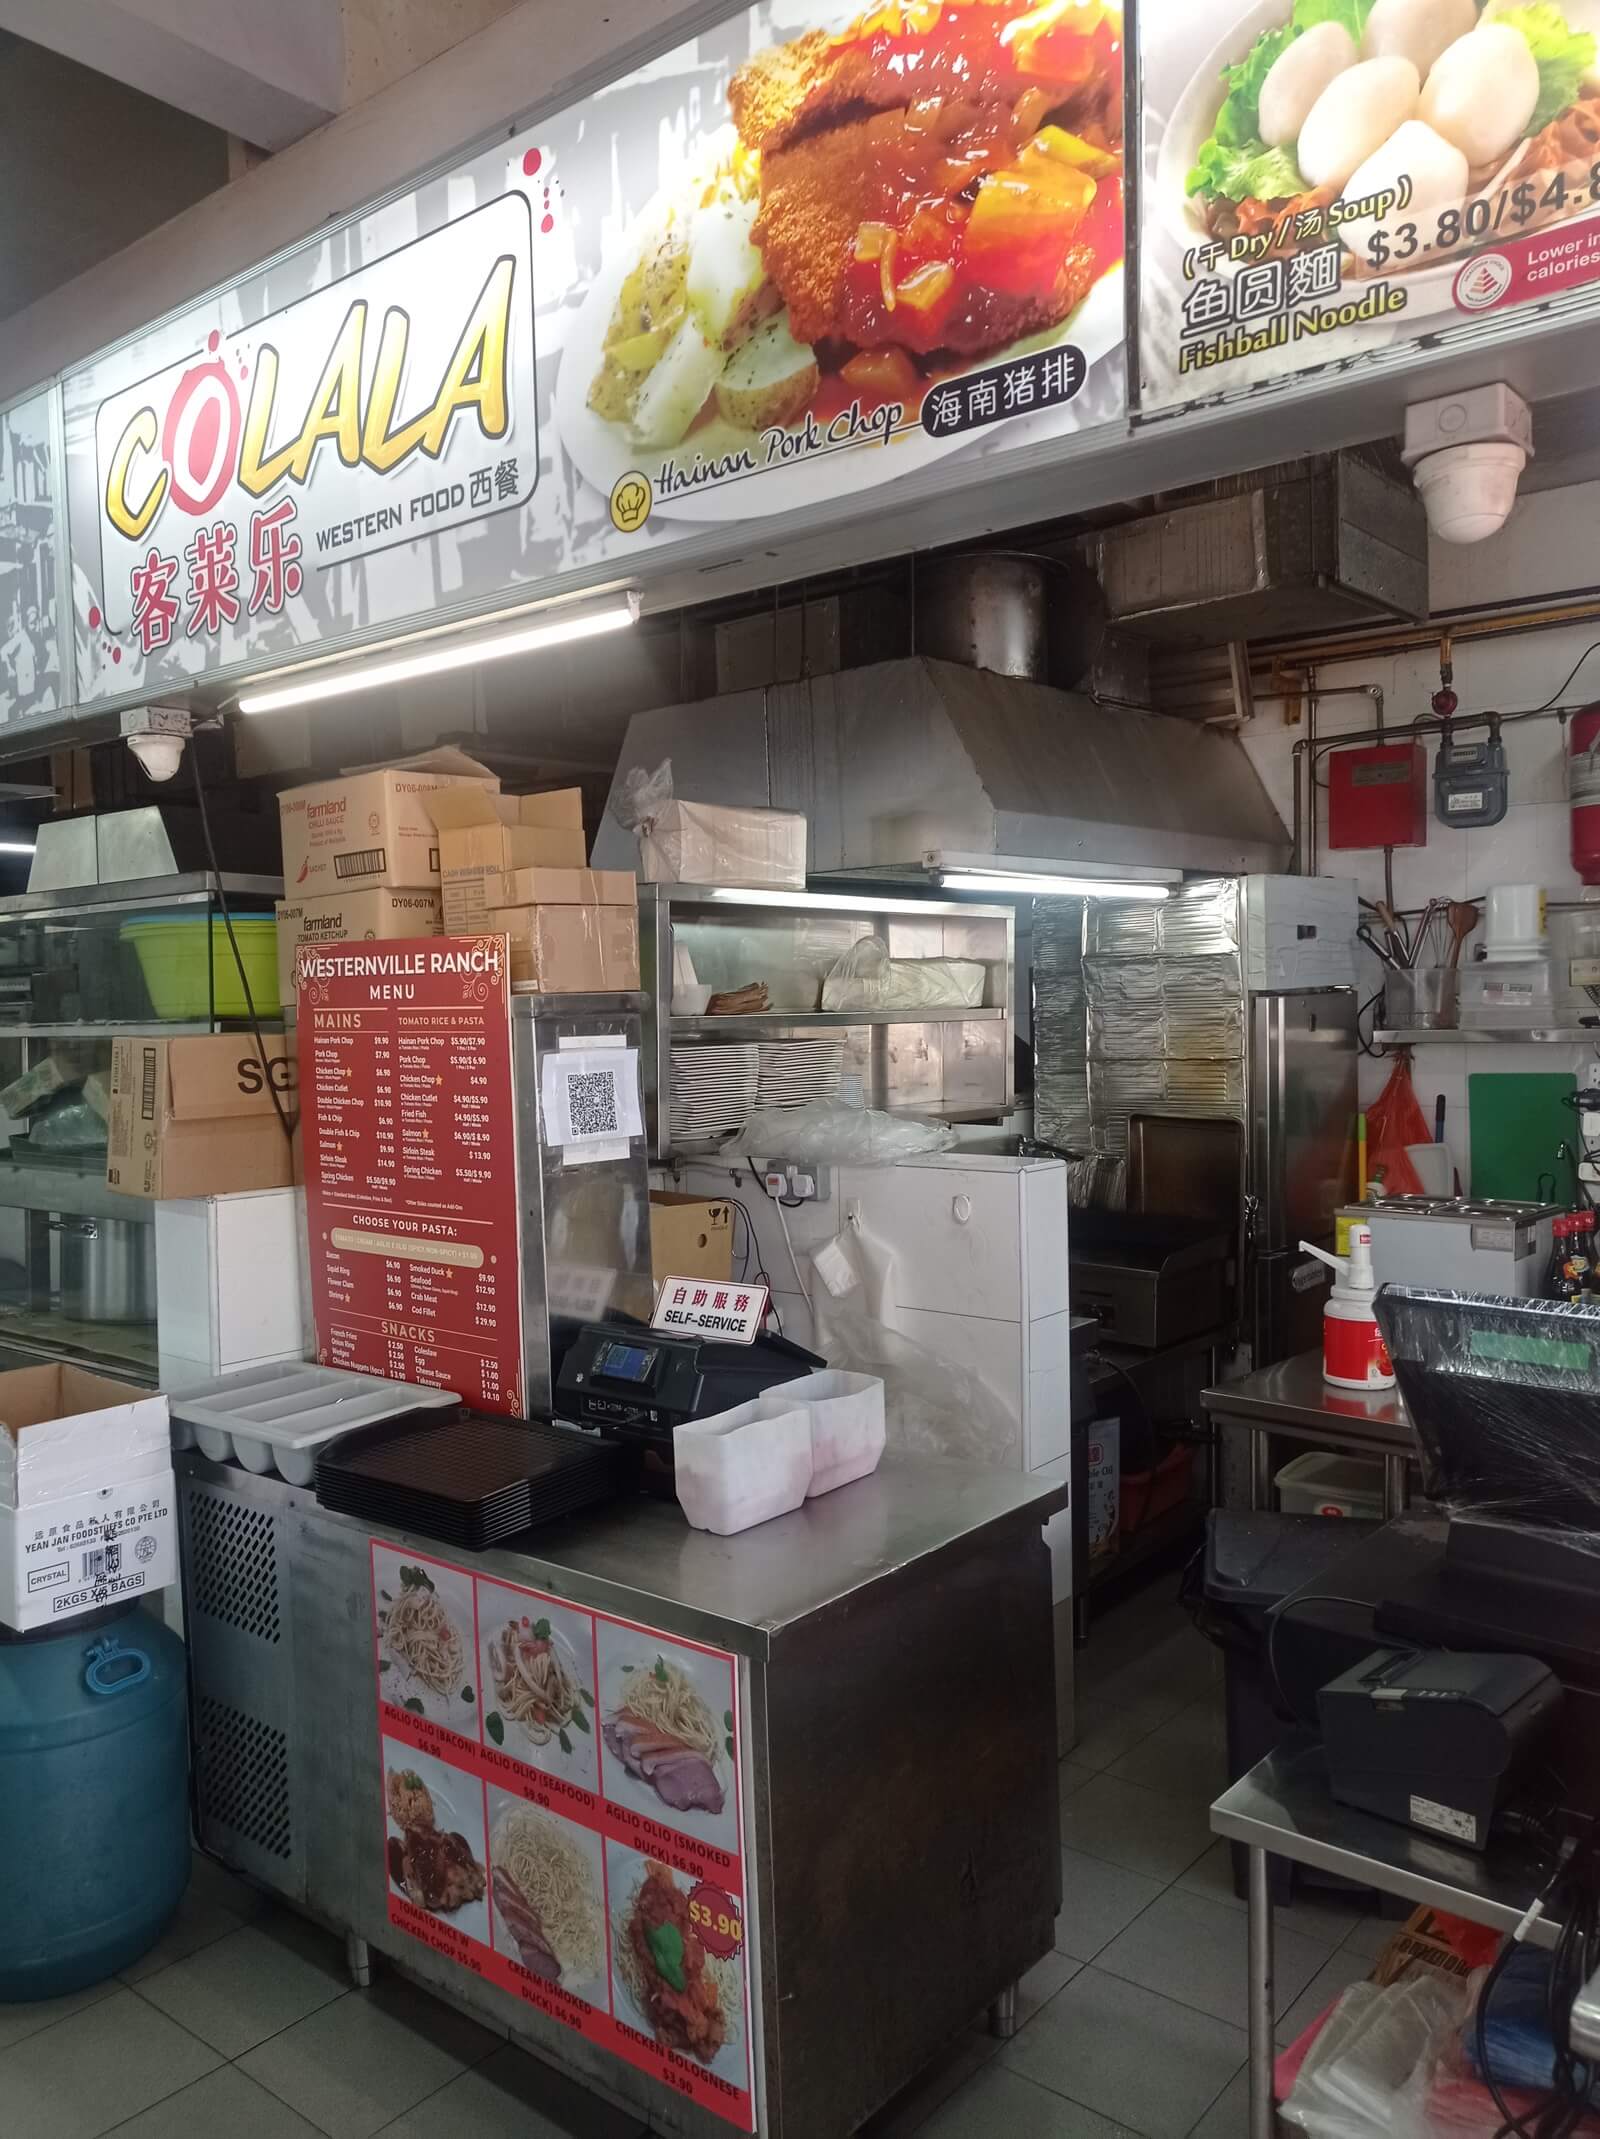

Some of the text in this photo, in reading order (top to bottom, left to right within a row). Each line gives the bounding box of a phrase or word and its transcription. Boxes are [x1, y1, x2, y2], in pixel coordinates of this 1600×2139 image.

[1230, 231, 1273, 262] Dry
[1295, 208, 1322, 240] 汤
[1528, 239, 1583, 266] Lower
[1180, 241, 1340, 339] 鱼圆麵
[1179, 283, 1407, 374] Fishball Noodle
[106, 254, 516, 542] COLALA
[653, 353, 1078, 495] Hainan Pork Chop 海南猪排
[316, 458, 520, 552] WESTERN FOOD 西餐
[131, 496, 303, 657] 客莱乐
[306, 796, 347, 819] farmland
[391, 898, 434, 909] DY06-007M
[303, 912, 342, 931] farmland
[298, 929, 348, 943] TOMATO KETCHUP
[300, 950, 499, 978] WESTERNVILLE RANCH
[369, 984, 415, 1000] MENU
[314, 1013, 361, 1029] MAINS
[398, 1015, 485, 1026] TOMATO RICE & PASTA
[398, 1037, 416, 1045] Hainan
[416, 1037, 430, 1045] Pork
[430, 1037, 444, 1047] Chop
[399, 1055, 426, 1065] Pork Chop
[400, 1074, 487, 1085] Chicken Chop $4.90
[400, 1093, 421, 1101] Chicken
[421, 1093, 438, 1102] Cutlet
[401, 1109, 415, 1117] Fried
[415, 1110, 427, 1118] Fish
[402, 1128, 421, 1137] Salmon
[419, 1147, 435, 1156] Steak
[403, 1165, 442, 1175] Spring Chicken
[352, 1214, 458, 1237] CHOOSE YOUR PASTA:
[409, 1263, 431, 1275] Smoked
[431, 1266, 445, 1276] Duck
[410, 1275, 496, 1295] Seafood $12.90
[411, 1292, 424, 1301] Crab
[476, 1302, 496, 1313] $12.90
[411, 1305, 436, 1317] Cod Fillet
[672, 1286, 750, 1313] 自助服務
[381, 1321, 435, 1343] SNACKS
[664, 1309, 747, 1333] SELF-SERVICE
[415, 1355, 425, 1366] Egg
[415, 1365, 435, 1377] Cheese
[25, 1541, 50, 1554] YEAN
[51, 1534, 70, 1547] JAN
[71, 1520, 123, 1541] FOODSTUFFS
[125, 1516, 136, 1527] CO
[138, 1512, 153, 1523] PTE
[154, 1508, 168, 1520] LTD
[31, 1569, 67, 1586] CRYSTAL
[56, 1591, 88, 1610] 2KGS
[111, 1575, 142, 1593] BAGS
[384, 1705, 476, 1758] AGLIO OLIO (BACON)
[480, 1748, 595, 1810] AGLIO OLIO (SEAFOOD)
[606, 1804, 730, 1868] AGLIO OLIO (SMOKED
[633, 1837, 703, 1878] DUCK) $6.90
[399, 1901, 436, 1928] TOMATO
[438, 1921, 457, 1941] RICE
[689, 1900, 742, 1942] $3.90
[391, 1912, 429, 1943] CHICKEN
[430, 1936, 455, 1957] CHOP
[508, 1960, 592, 2015] CREAM (SMOKED
[522, 1986, 553, 2017] DUCK)
[615, 2021, 740, 2100] CHICKEN BOLOGNESE
[662, 2067, 693, 2094] $3.90
